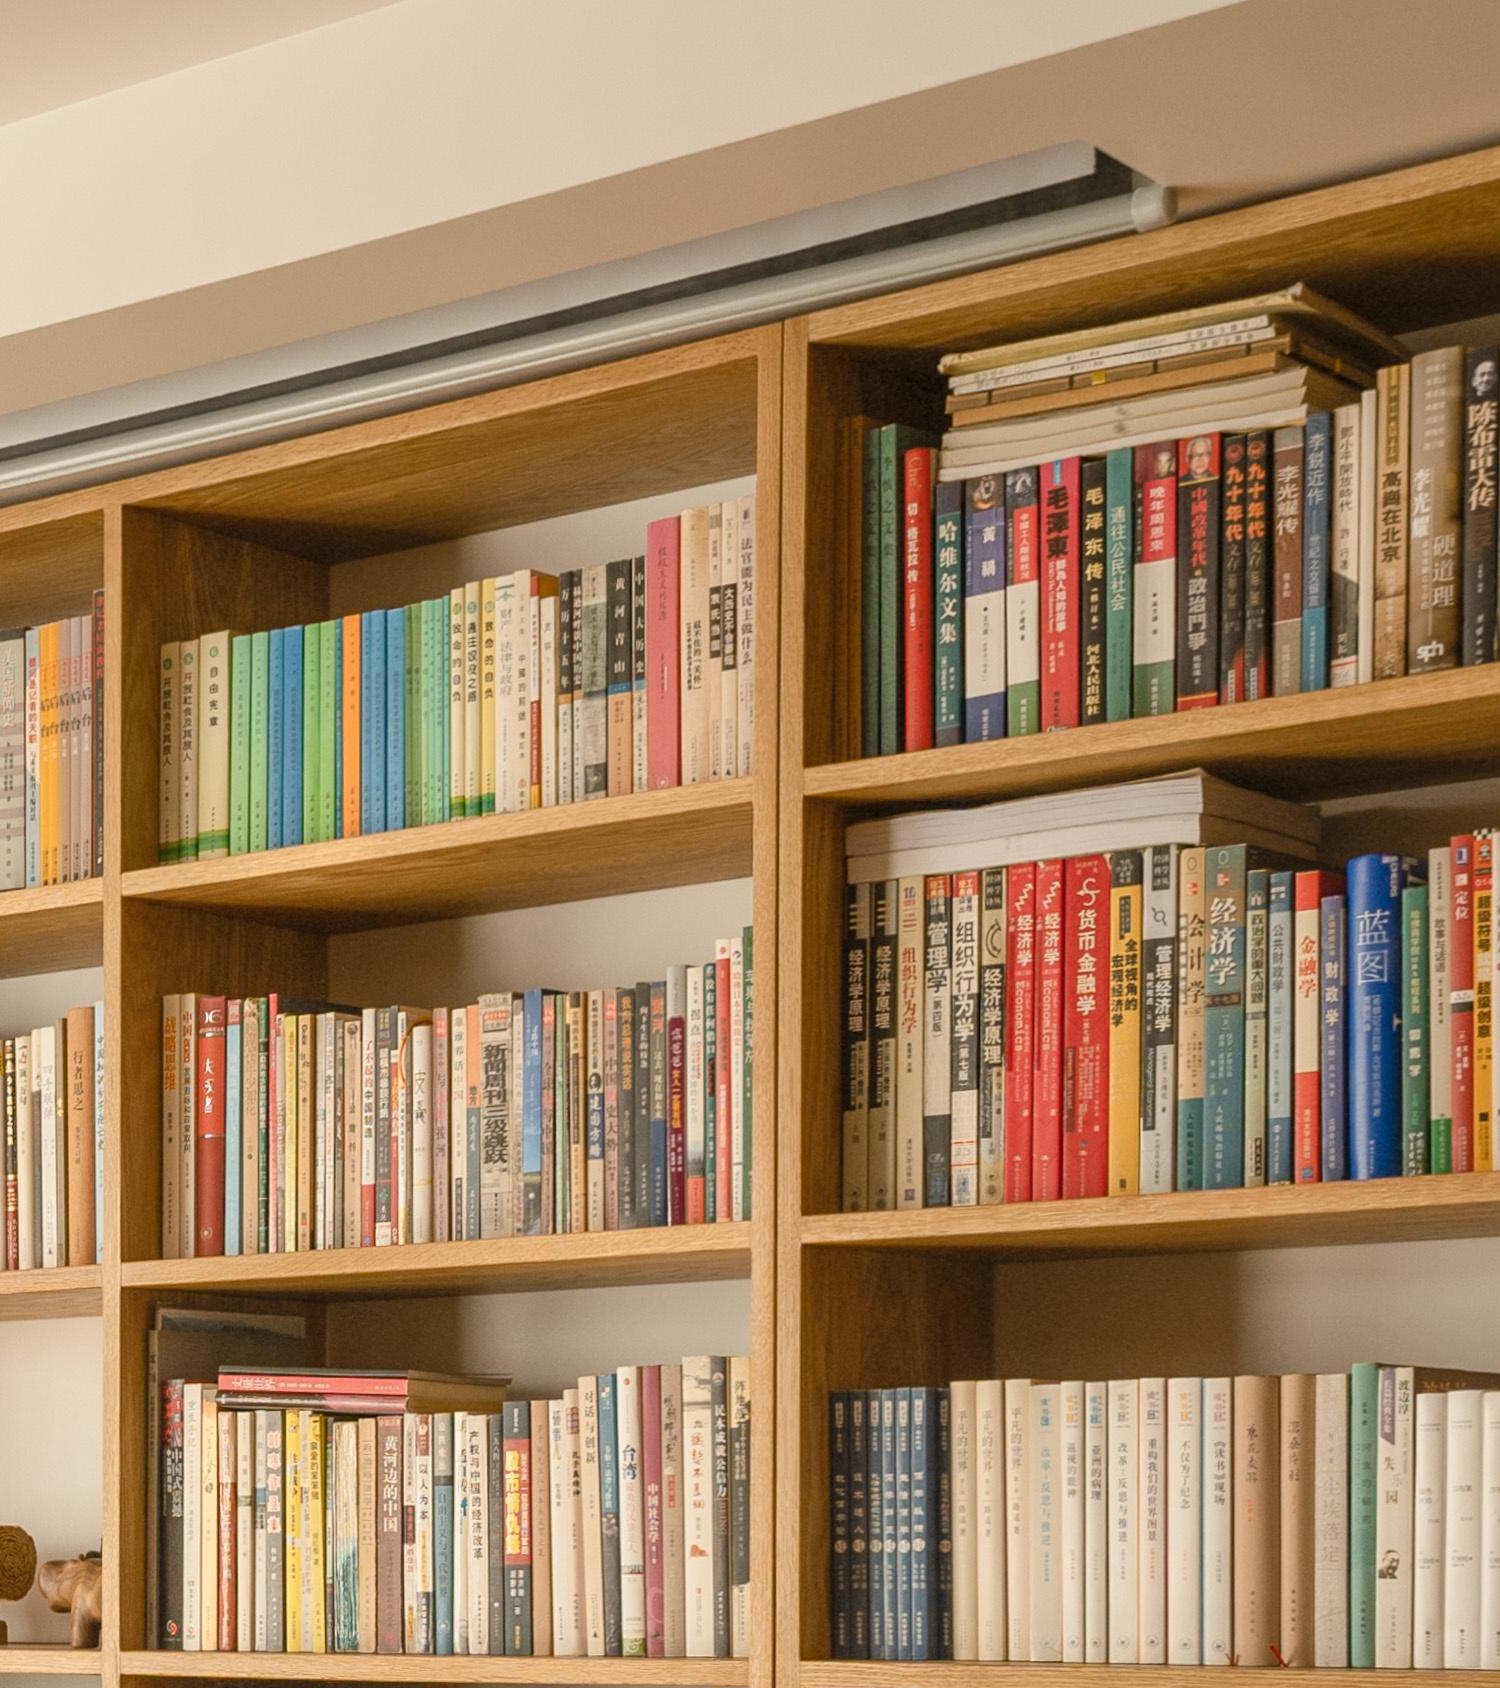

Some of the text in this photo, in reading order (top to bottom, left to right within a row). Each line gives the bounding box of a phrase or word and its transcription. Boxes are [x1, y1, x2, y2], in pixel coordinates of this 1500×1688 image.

[1467, 403, 1497, 512] 陈布雷大传
[1046, 487, 1070, 558] 毛澤東
[1084, 488, 1105, 580] 毛泽东传
[1224, 465, 1243, 539] 九十年代
[1247, 464, 1265, 537] 九十年代
[1275, 465, 1298, 536] 李光耀传
[1412, 468, 1430, 539] 李光耀
[938, 524, 957, 645] 哈维尔文集
[1109, 506, 1127, 611] 通往公民社会
[1431, 534, 1455, 607] 硬道理
[614, 575, 626, 677] 黄河青山
[635, 569, 645, 675] 中国大历史
[1017, 915, 1033, 966] 经济学
[1043, 913, 1060, 965] 经济学
[1209, 898, 1237, 984] 经济学
[1356, 910, 1390, 985] 蓝图
[1455, 891, 1469, 920] 定位
[848, 949, 864, 1032] 经济学原理
[875, 945, 892, 1029] 经济学原理
[901, 949, 918, 1035] 组织行为学
[926, 920, 948, 992] 管理学
[953, 920, 976, 1042] 组织行为学
[1076, 909, 1096, 1015] 货币金融学
[1111, 954, 1124, 1027] 宏观经济学
[1124, 938, 1138, 1011] 全球视角的
[1154, 944, 1171, 1032] 管理经济学
[1187, 915, 1205, 1007] 会计学
[1251, 914, 1264, 1006] 政治学的重大问题
[1272, 924, 1285, 992] 公共财政学
[1299, 935, 1317, 999] 金融学
[1324, 962, 1339, 1027] 财政学
[1477, 895, 1492, 1038] 超级符号 超级创意
[982, 969, 1003, 1064] 经济学原理
[483, 1043, 510, 1166] 新闻周刊三级跳跃
[956, 1410, 969, 1473] 平凡的世界
[383, 1435, 398, 1534] 黄河边的中国
[468, 1430, 483, 1559] 产权与中国的经济改革
